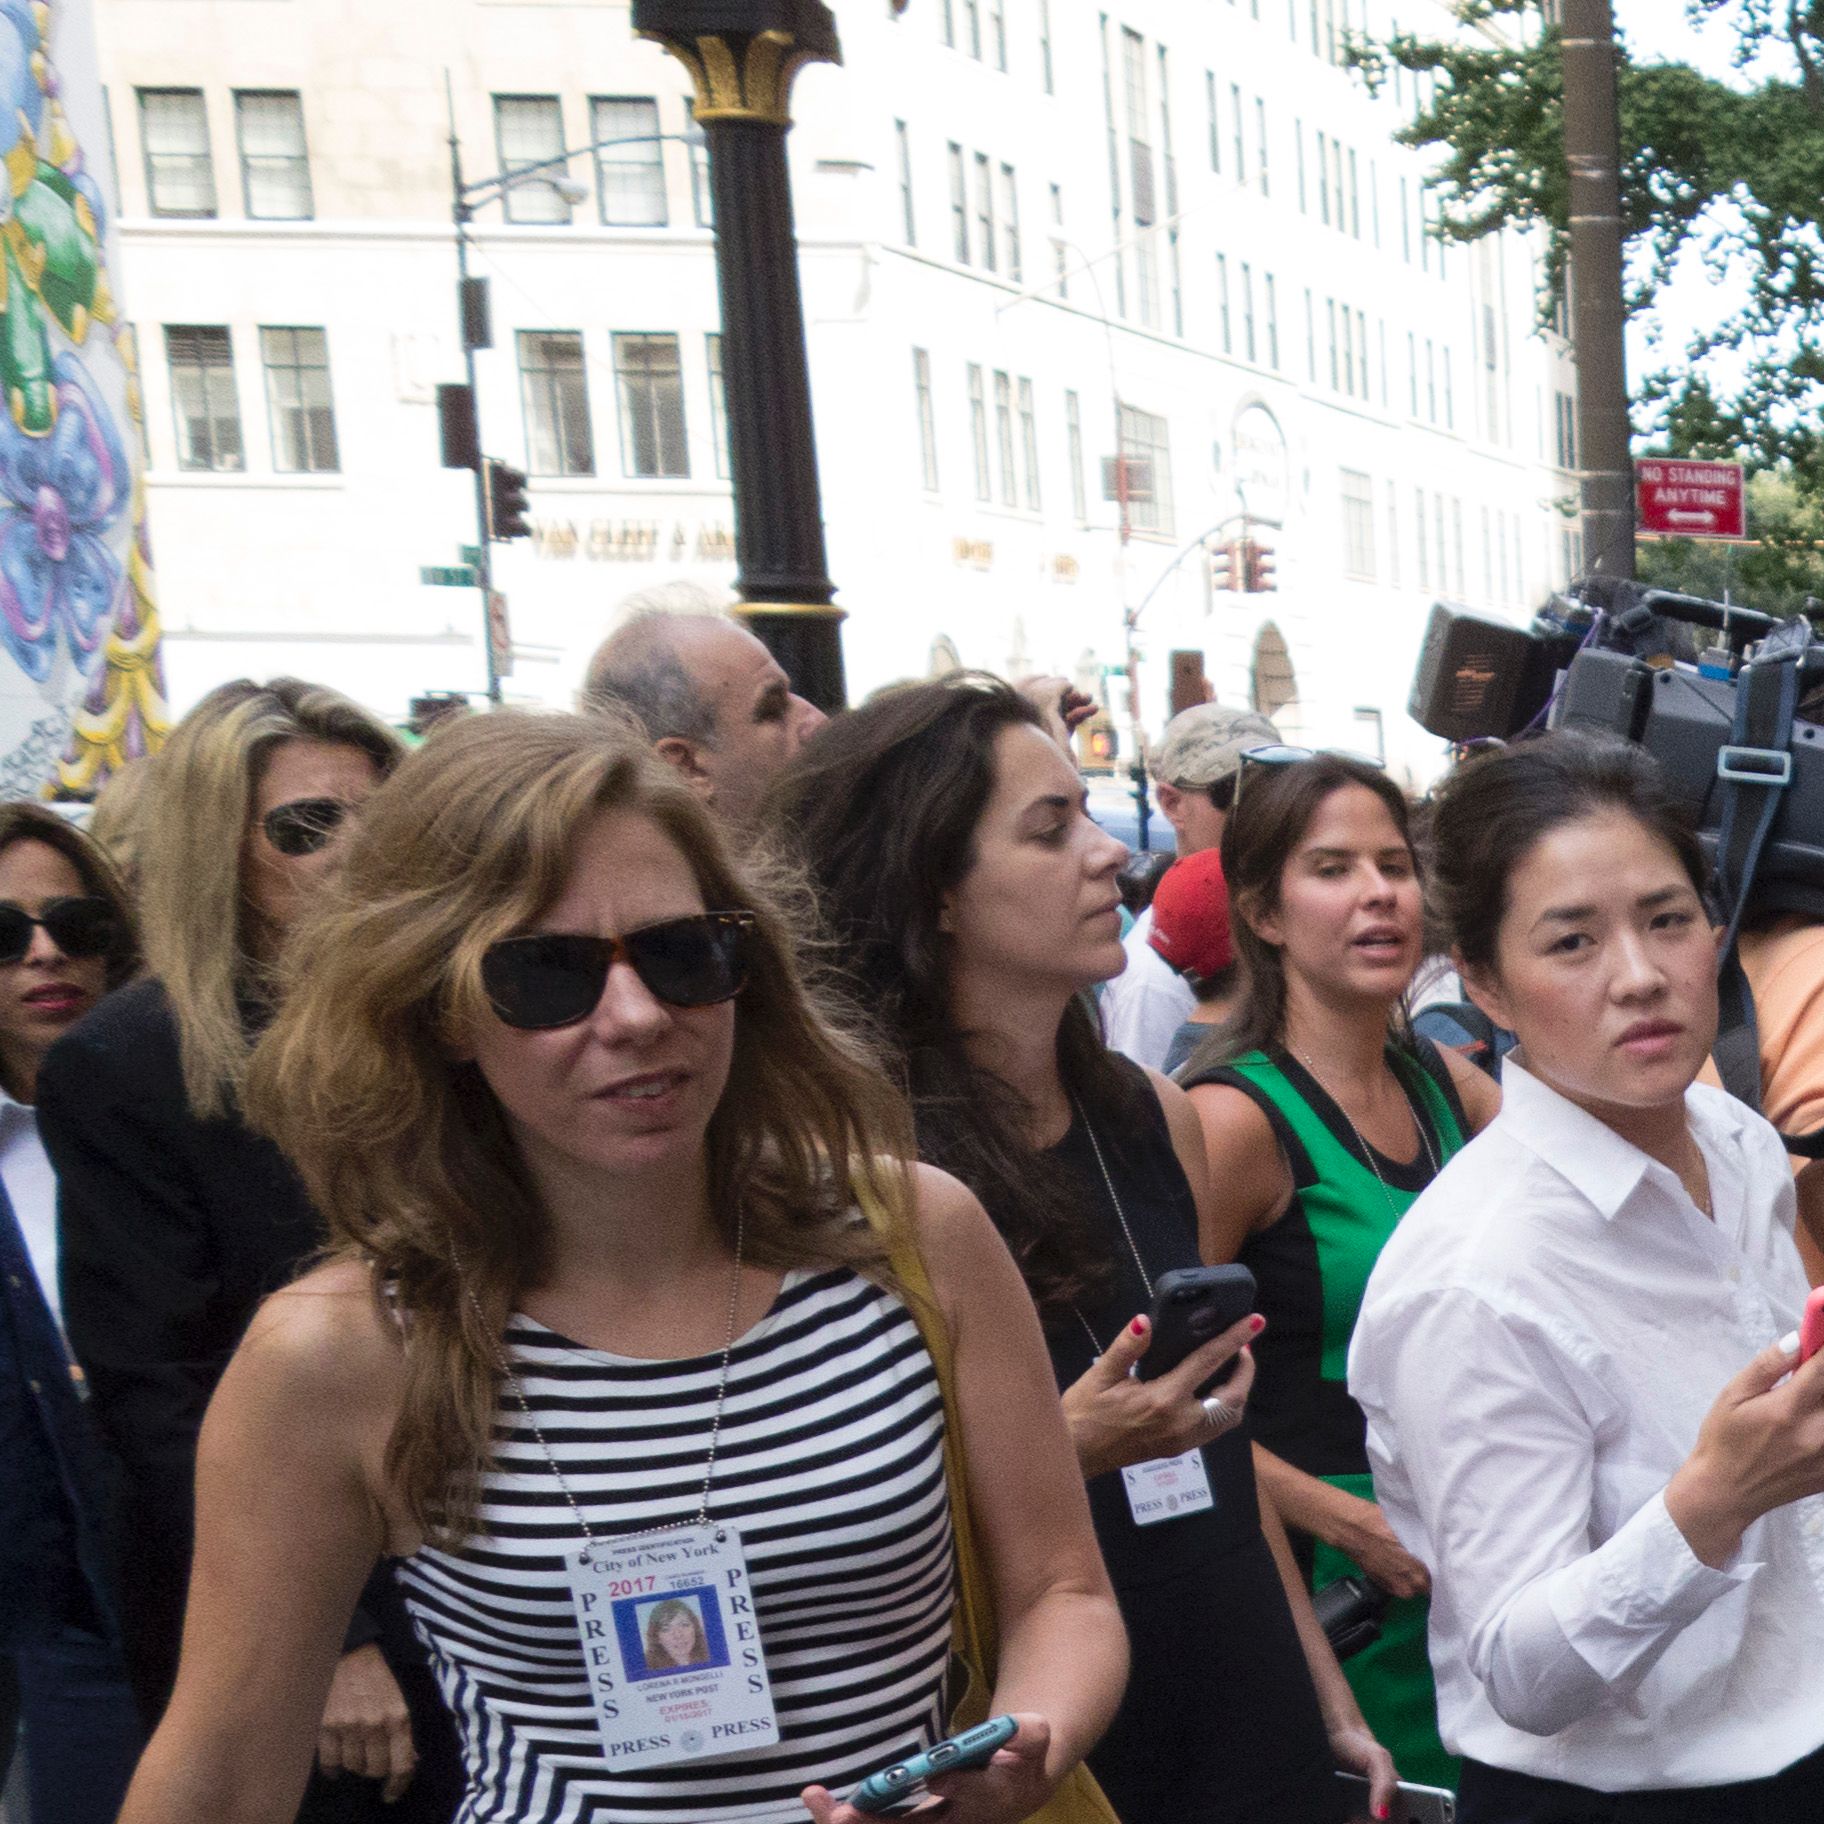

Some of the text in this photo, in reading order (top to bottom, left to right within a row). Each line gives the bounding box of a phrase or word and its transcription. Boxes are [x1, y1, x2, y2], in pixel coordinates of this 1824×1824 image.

[1641, 466, 1736, 486] NO STANDING
[1654, 487, 1727, 506] ANYTIME
[593, 1544, 719, 1574] City of New York
[608, 1575, 656, 1598] 2017
[646, 1684, 719, 1702] NEW YORK POST
[610, 1717, 772, 1757] PRESS PRESS
